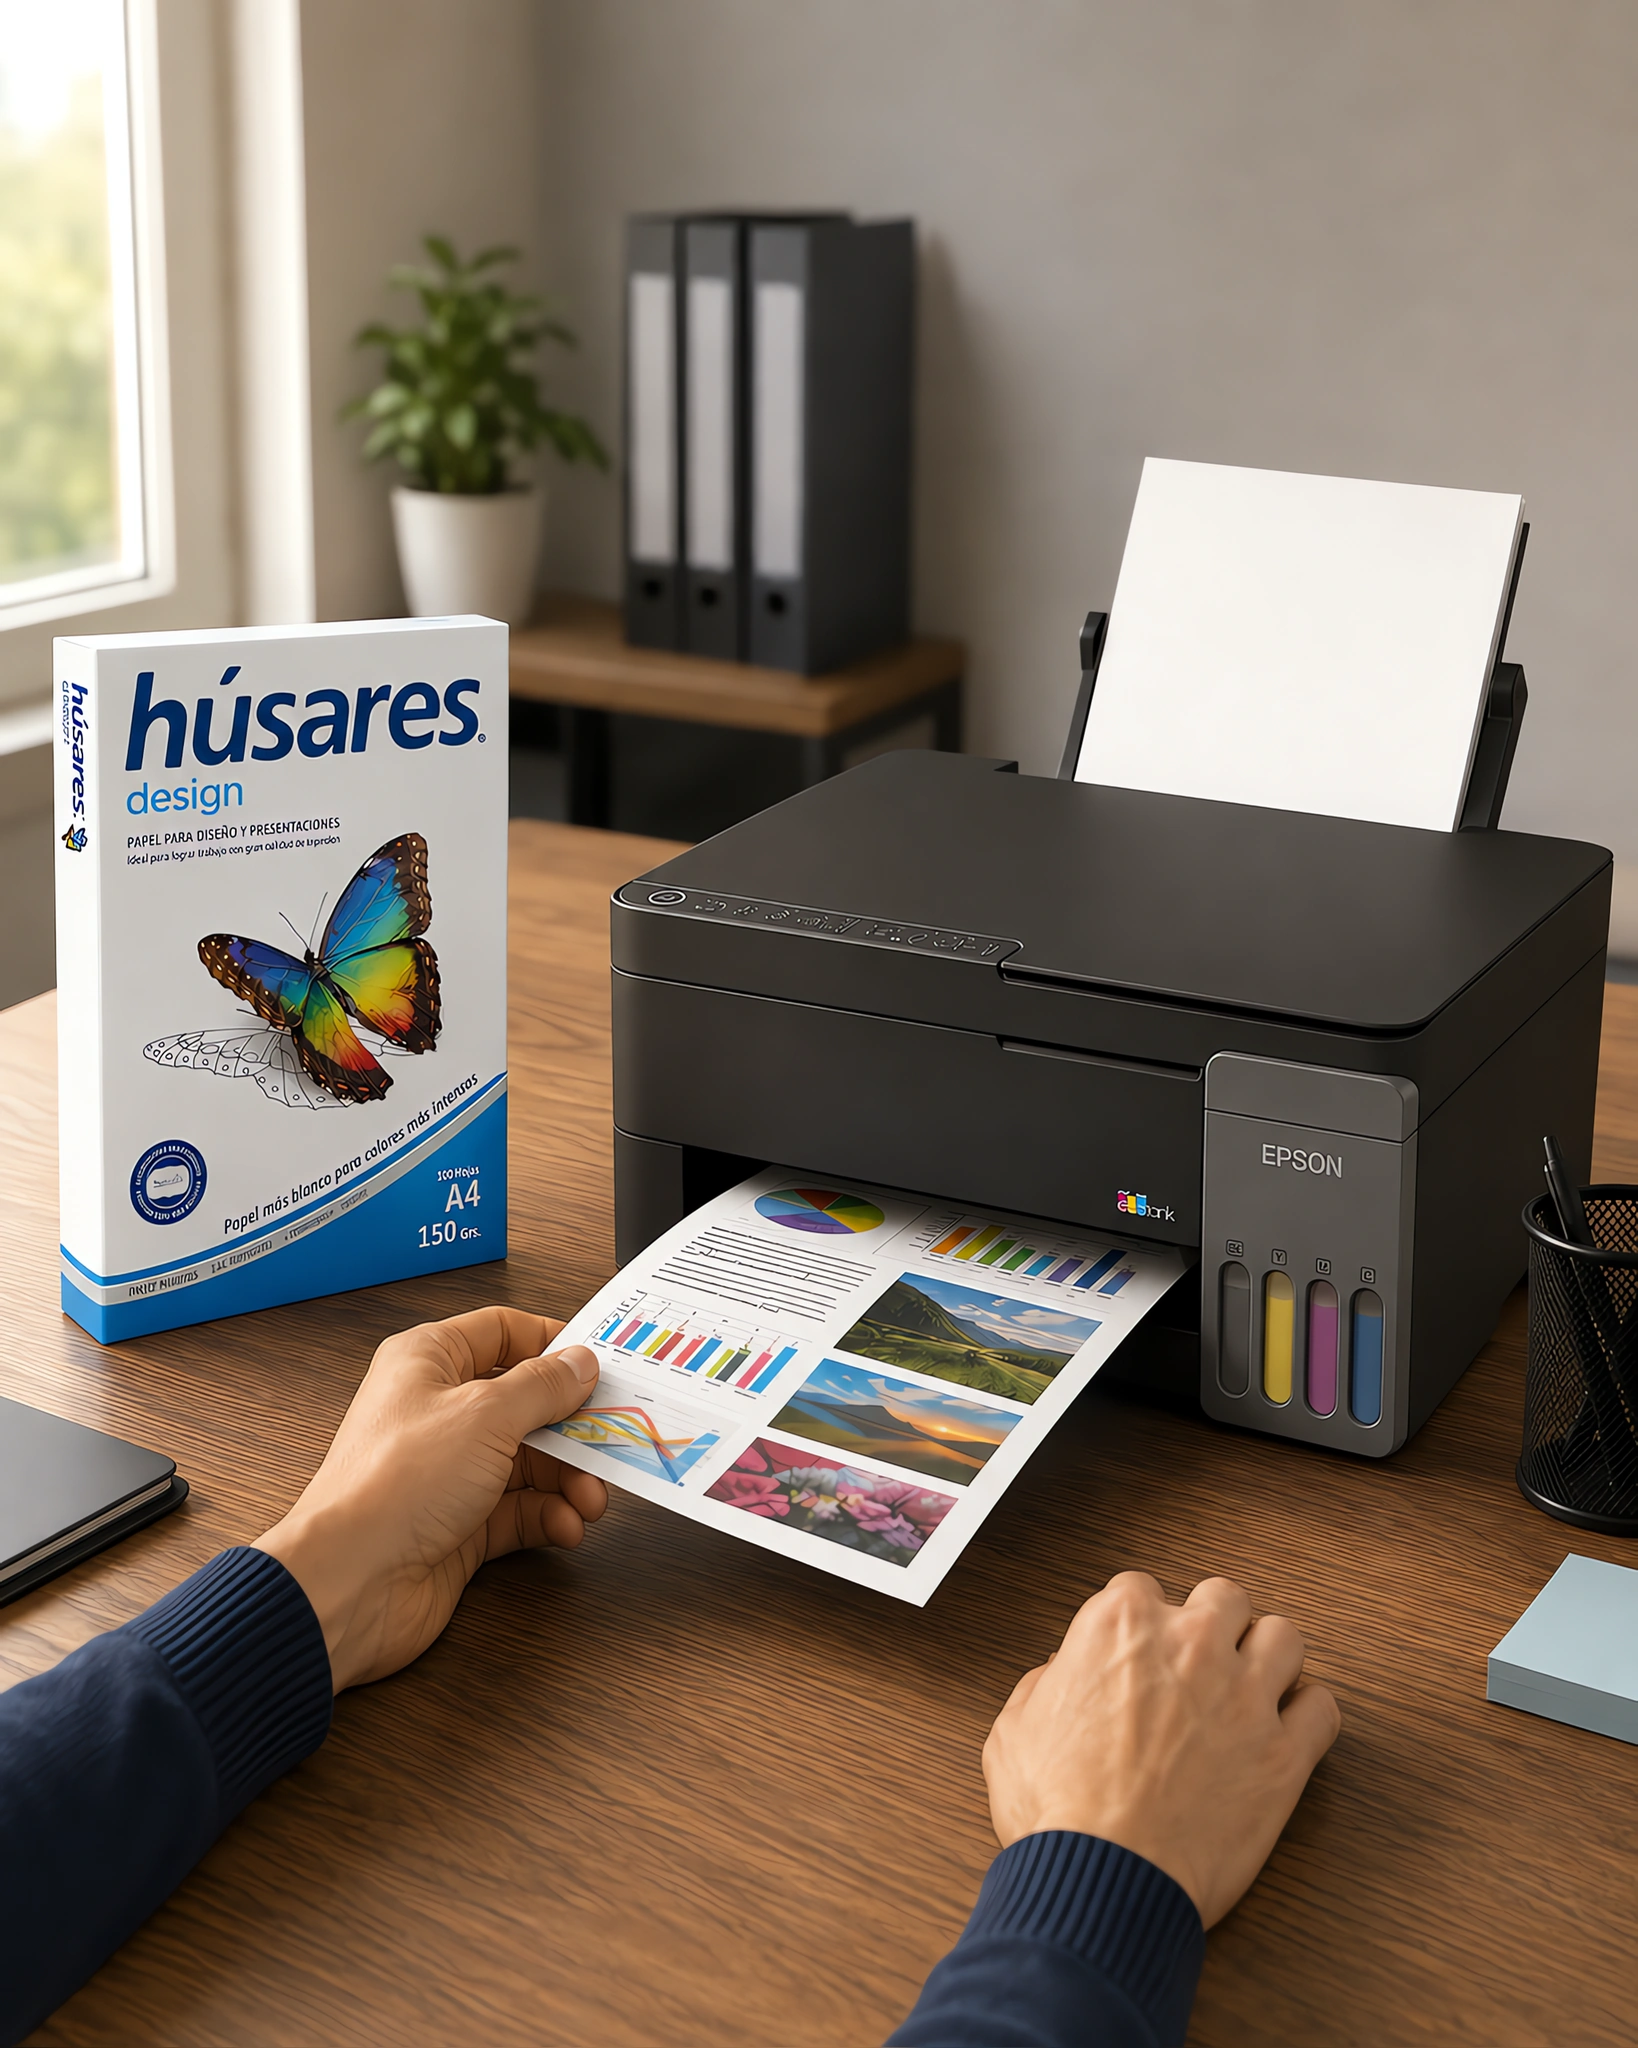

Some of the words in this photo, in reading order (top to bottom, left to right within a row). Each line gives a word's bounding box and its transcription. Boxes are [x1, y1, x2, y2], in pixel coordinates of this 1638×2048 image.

[126, 778, 243, 815] design
[127, 834, 161, 848] PAPEL
[164, 832, 193, 844] PARA
[197, 824, 237, 841] DISEÑO
[240, 825, 247, 837] Y
[250, 817, 340, 836] PRESENTACIONES
[1262, 1143, 1342, 1179] EPSON
[291, 1174, 332, 1203] blanco
[335, 1156, 362, 1184] para
[444, 1179, 481, 1213] A4
[418, 1220, 457, 1248] 150
